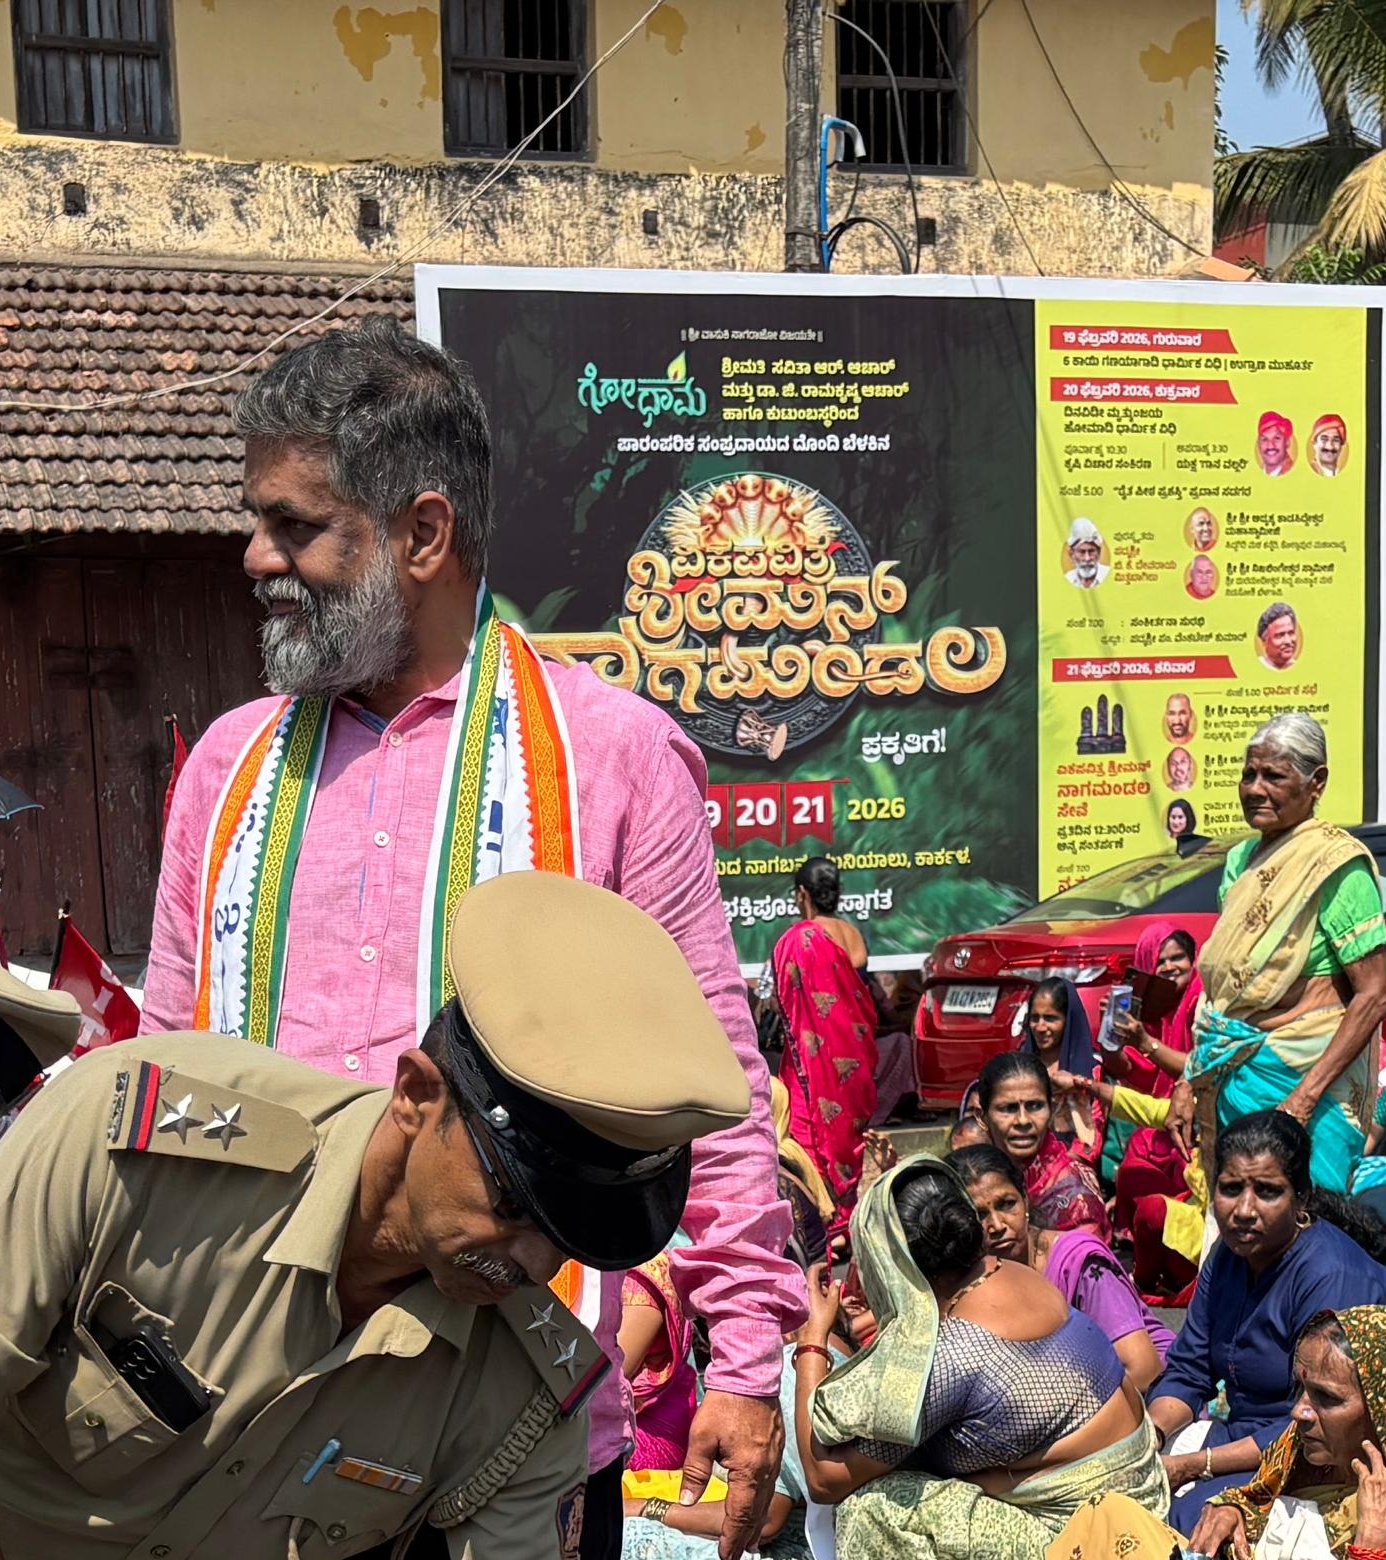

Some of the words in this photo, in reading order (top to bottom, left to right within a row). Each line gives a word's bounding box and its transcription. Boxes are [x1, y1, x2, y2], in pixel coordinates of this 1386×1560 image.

[1078, 329, 1119, 347] ಫೆಬ್ರವರಿ
[1152, 332, 1202, 346] ಗುರುವಾರ
[721, 357, 766, 378] ಶ್ರೀಮತಿ
[771, 359, 812, 374] ಸವಿತಾ
[814, 359, 845, 375] ಆರ್.
[847, 359, 896, 375] ಆಚಾರ್
[721, 382, 755, 403] ಮತ್ತು
[756, 383, 780, 397] ಡಾ.
[782, 382, 799, 398] ಜಿ.
[801, 382, 862, 404] ರಾಮಕೃಷ್ಣ
[861, 381, 910, 398] ಆಚಾರ್
[1063, 384, 1078, 396] 20
[1080, 382, 1121, 399] ಫೆಬ್ರವರಿ
[1155, 384, 1201, 400] ಶುಕ್ರವಾರ
[722, 405, 764, 421] ಹಾಗೂ
[766, 405, 860, 428] ಕುಟುಂಬಸ್ಥರಿಂದ
[1116, 422, 1157, 436] ಧಾರ್ಮಿಕ
[617, 434, 695, 453] ಪಾರಂಪರಿಕ
[697, 434, 794, 456] ಸಂಪ್ರದಾಯದ
[794, 433, 840, 453] ದೊಂದಿ
[842, 433, 891, 452] ಬೆಳಕಿನ
[670, 533, 839, 584] ಏಕಪವಿತ್ರ
[618, 550, 908, 655] ಶ್ರೀಮನ್
[861, 728, 947, 765] ಪ್ರಕೃತಿಗೆ!
[1057, 779, 1151, 798] ನಾಗಮಂಡಲ
[736, 798, 778, 826] 20
[792, 796, 825, 824] 21
[847, 797, 906, 821] 2026
[1057, 802, 1088, 818] ಸೇವೆ
[838, 888, 894, 920] ಸ್ವಾಗತ
